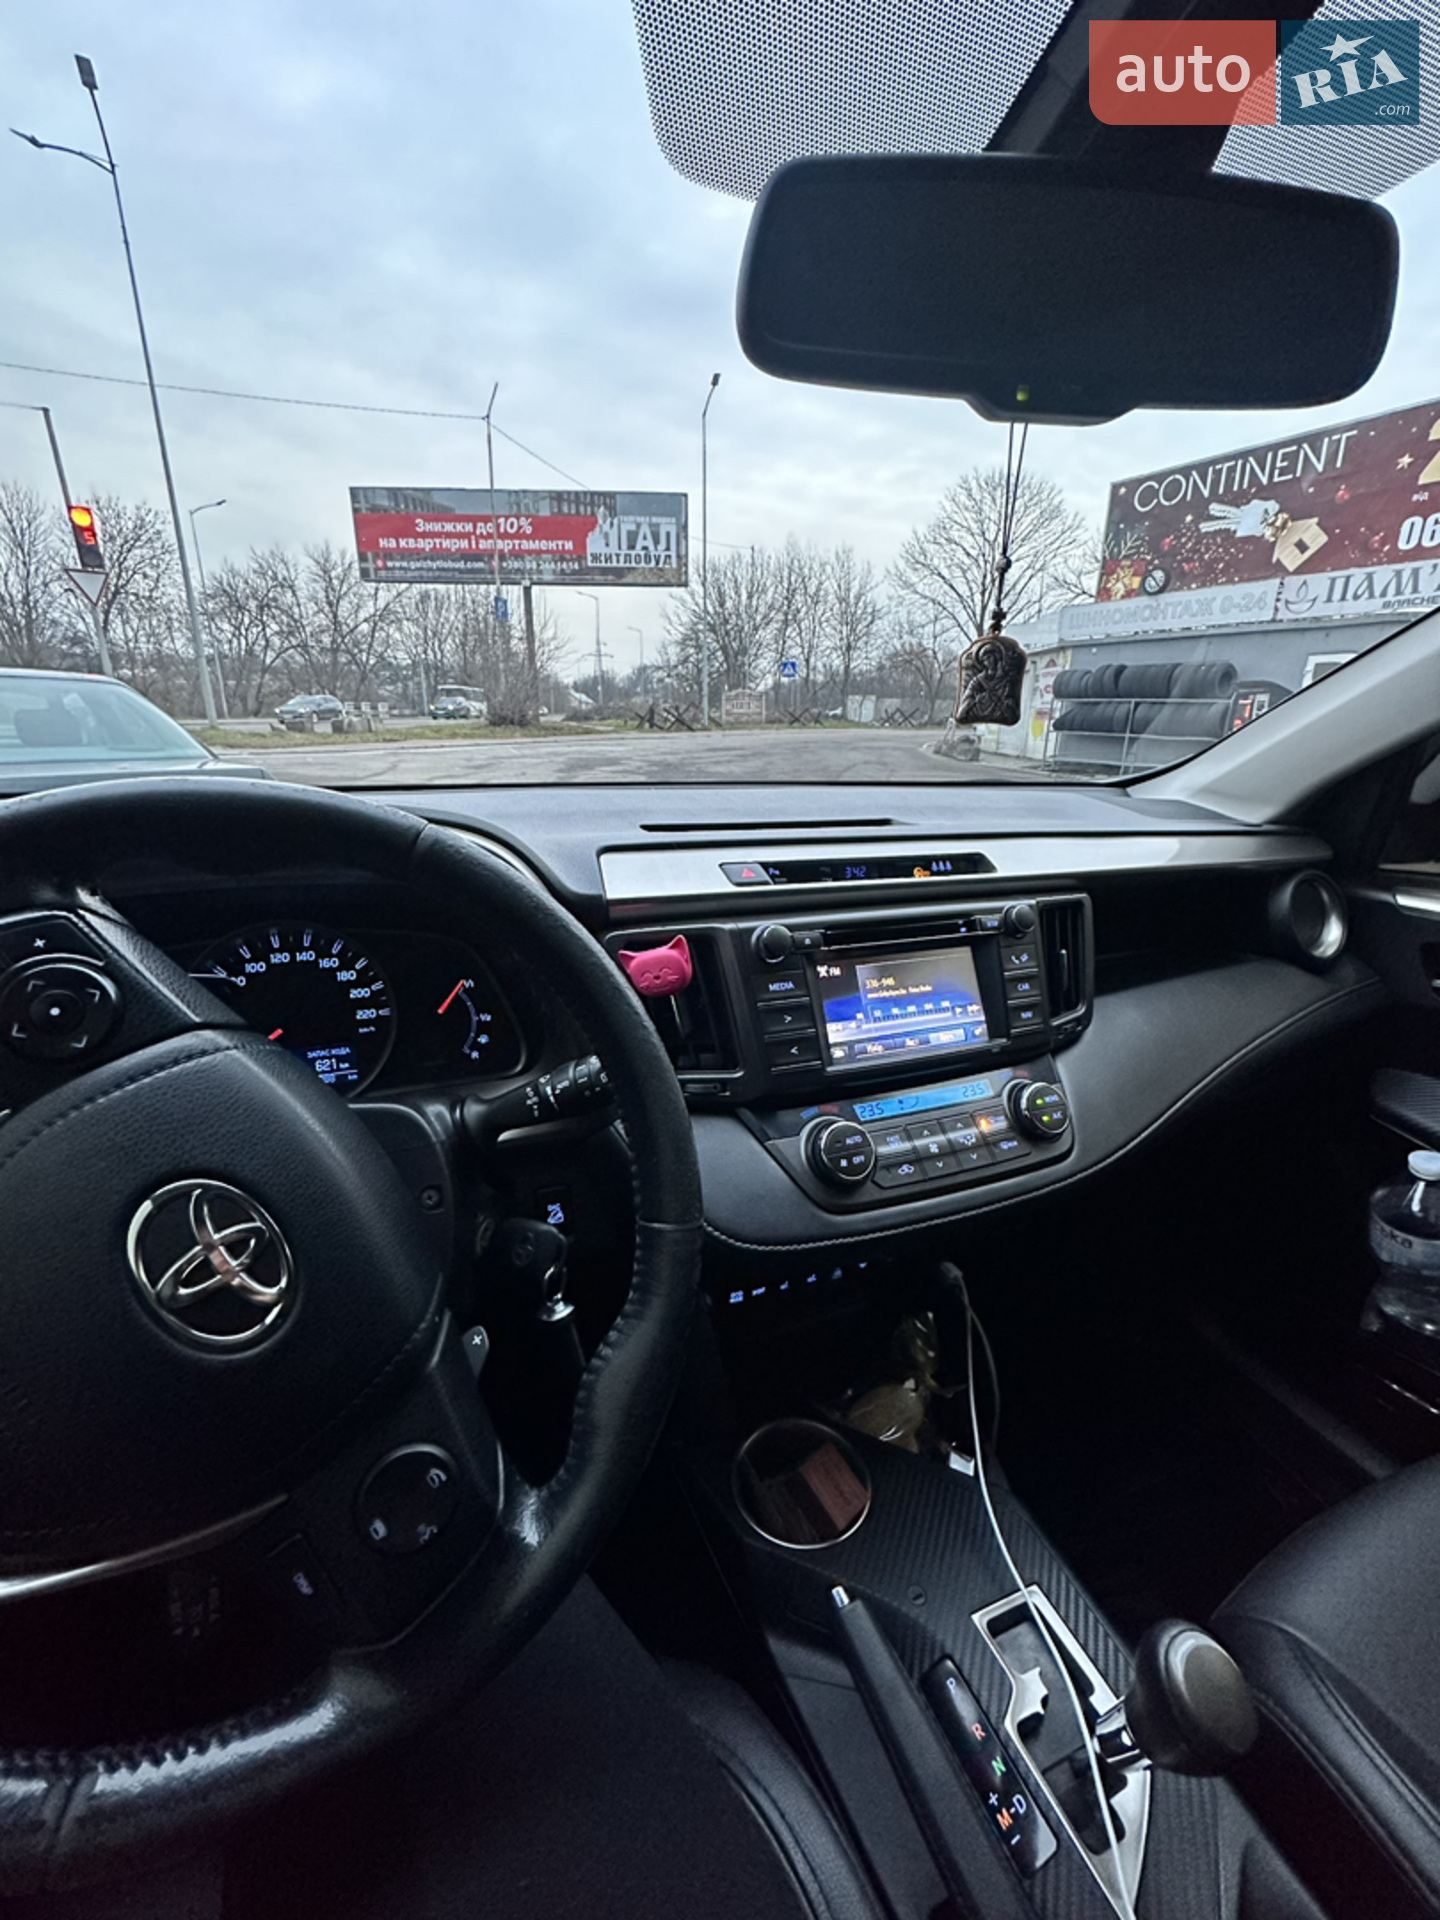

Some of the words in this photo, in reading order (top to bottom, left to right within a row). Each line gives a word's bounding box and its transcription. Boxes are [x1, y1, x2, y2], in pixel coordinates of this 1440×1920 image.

[1133, 429, 1358, 513] CONTINENT
[415, 518, 474, 533] Знижки
[476, 521, 494, 536] до
[497, 516, 533, 534] 10%
[378, 537, 398, 548] на
[399, 537, 469, 551] квартири
[470, 534, 477, 549] і
[478, 539, 574, 553] апартаменти
[589, 552, 672, 566] ЖИТЛОБУД
[1068, 597, 1216, 630] ШИНОМОНТАЖ
[1219, 590, 1269, 615] 0-24
[270, 952, 290, 964] 120
[296, 951, 316, 962] 140
[319, 957, 339, 969] 160
[245, 961, 266, 974] 100
[336, 970, 357, 982] 180
[350, 987, 371, 999] 200
[768, 981, 795, 992] MEDIA
[356, 1009, 378, 1020] 220
[315, 1058, 337, 1072] 621
[971, 1723, 986, 1740] R
[991, 1756, 1006, 1777] N
